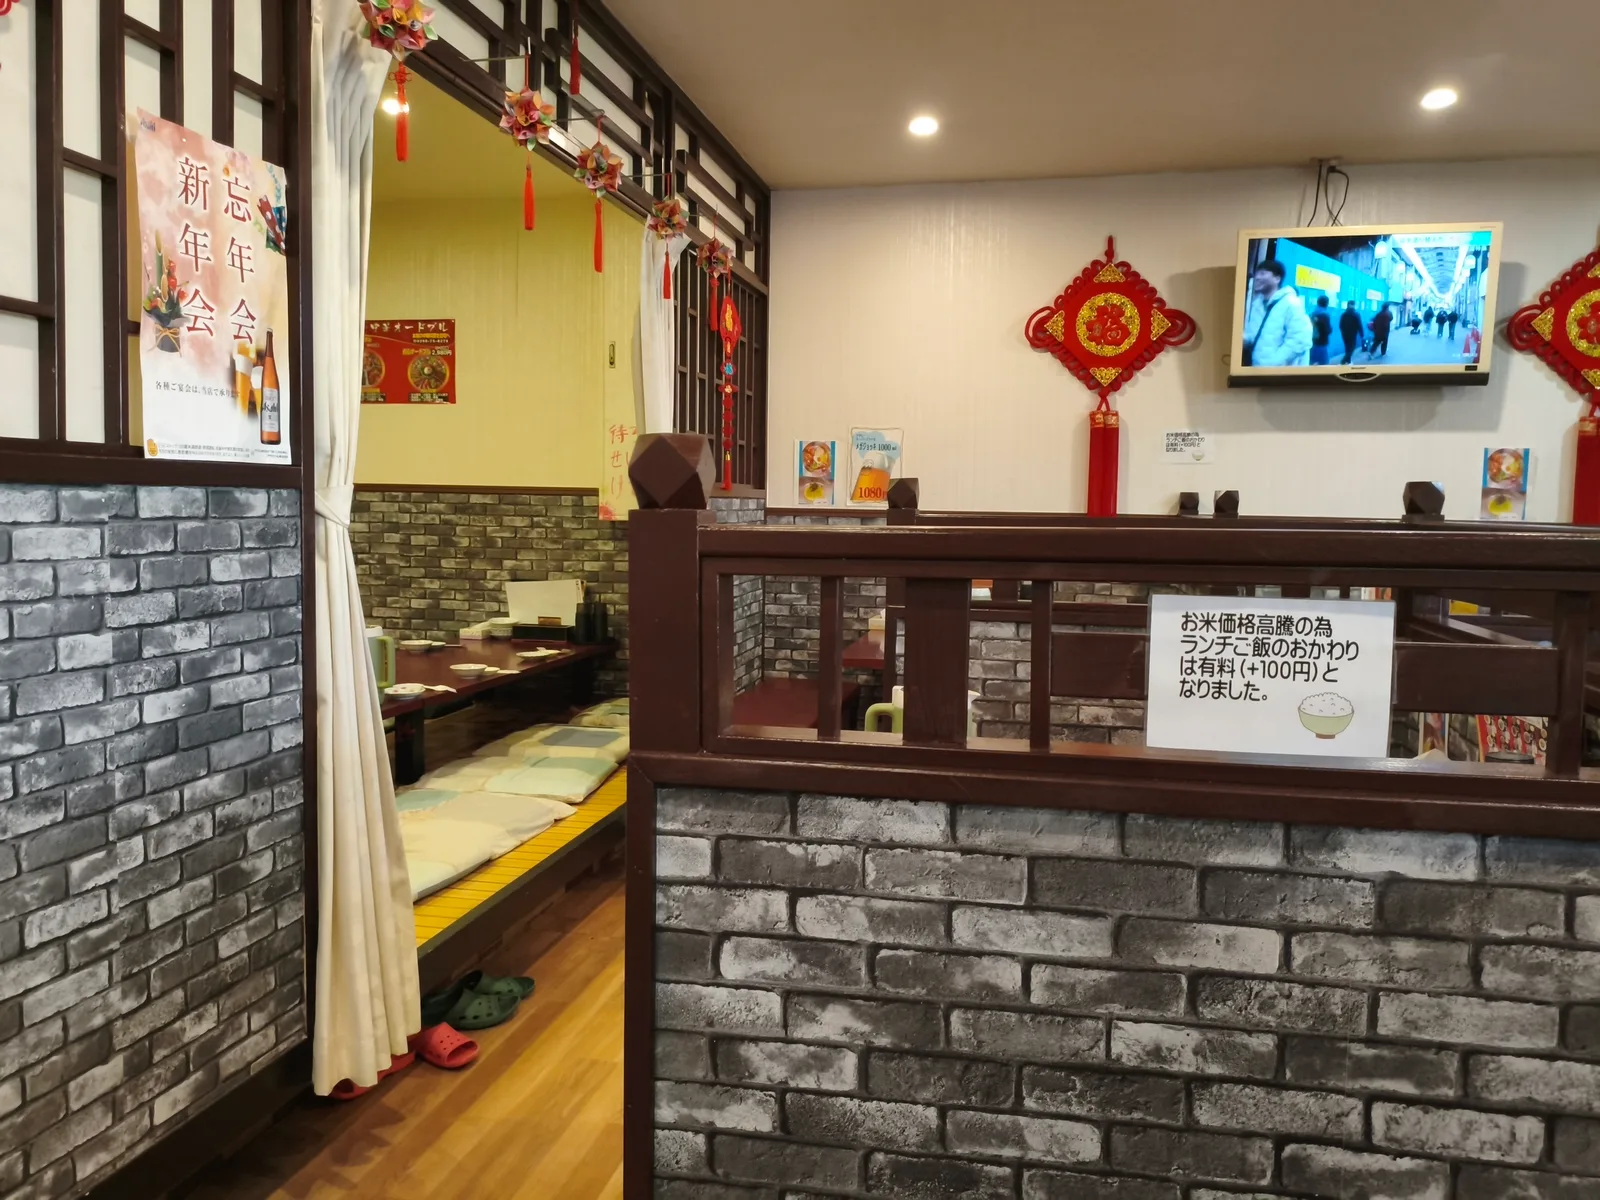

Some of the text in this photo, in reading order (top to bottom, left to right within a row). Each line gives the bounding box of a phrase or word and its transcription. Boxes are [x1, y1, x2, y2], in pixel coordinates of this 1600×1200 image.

[178, 156, 215, 337] 新年会
[222, 176, 257, 345] 忘年会
[878, 443, 892, 451] 1000
[1181, 611, 1333, 638] お米価格高騰の為
[1180, 634, 1360, 661] ランチご飯のおかわり
[1179, 677, 1268, 702] なりました。
